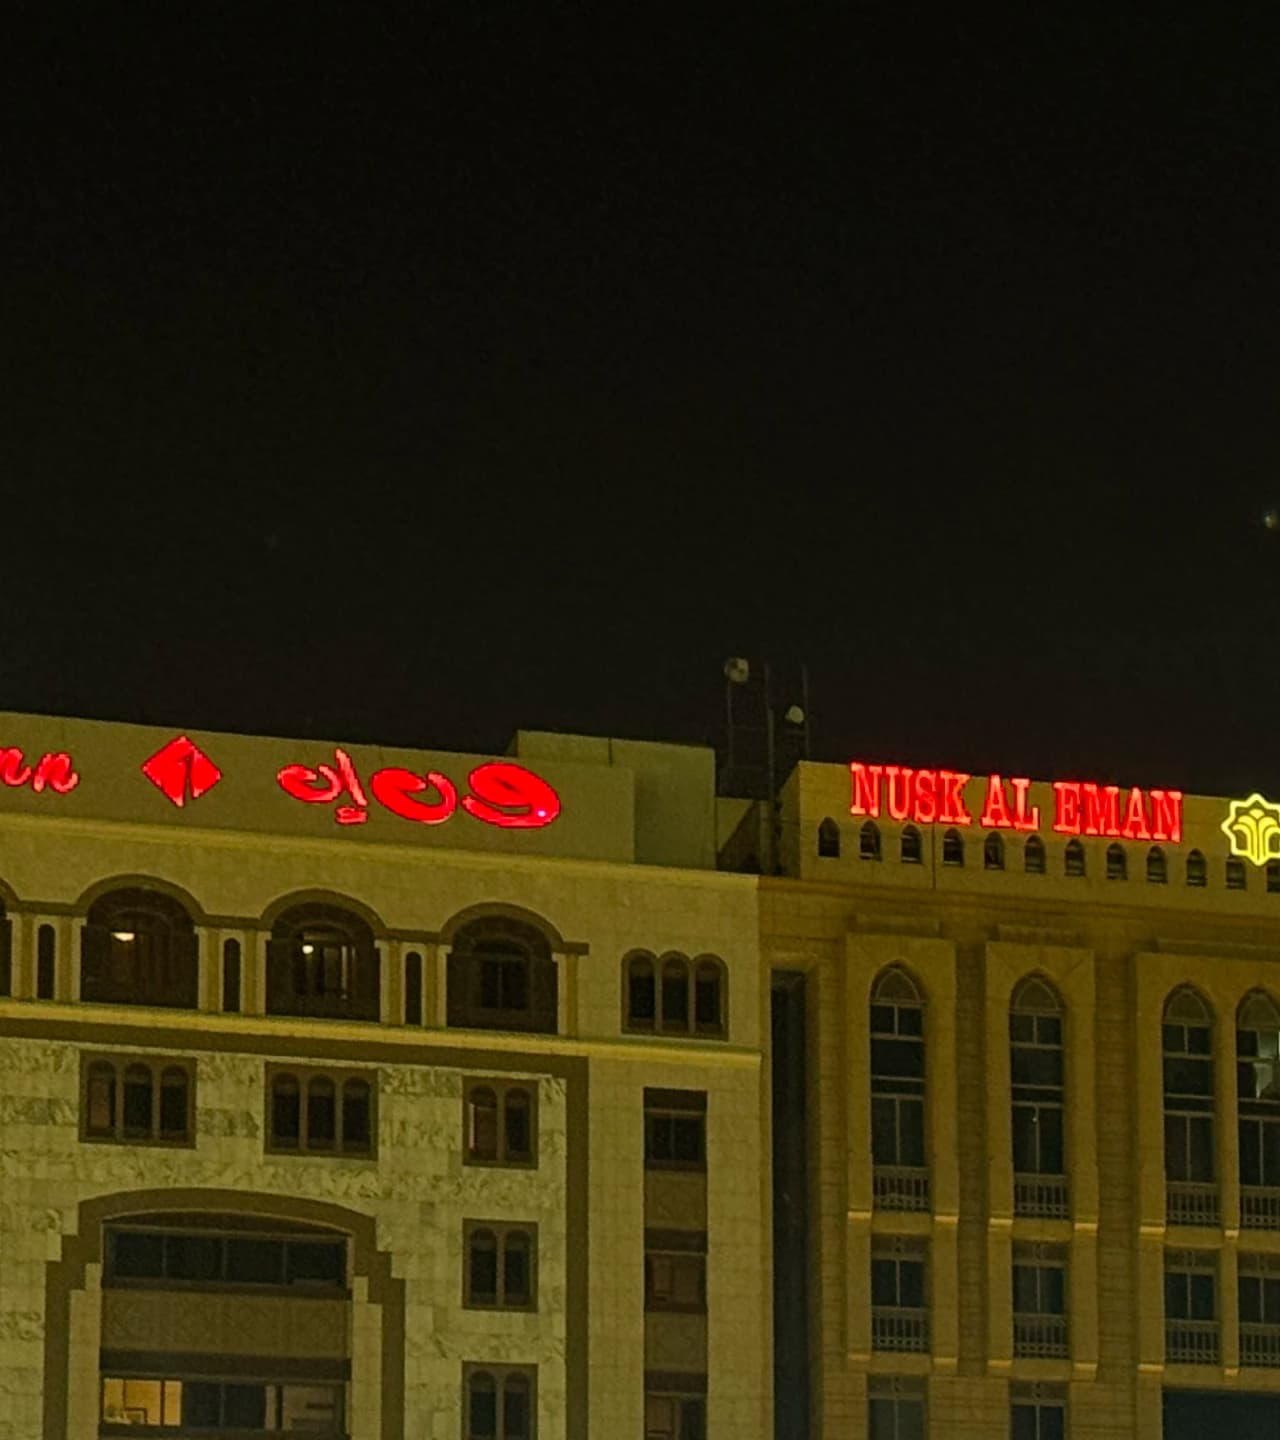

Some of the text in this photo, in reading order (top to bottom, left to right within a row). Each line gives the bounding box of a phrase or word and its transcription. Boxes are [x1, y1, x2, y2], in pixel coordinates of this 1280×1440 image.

[851, 762, 1182, 842] NUSK AL EMAN
